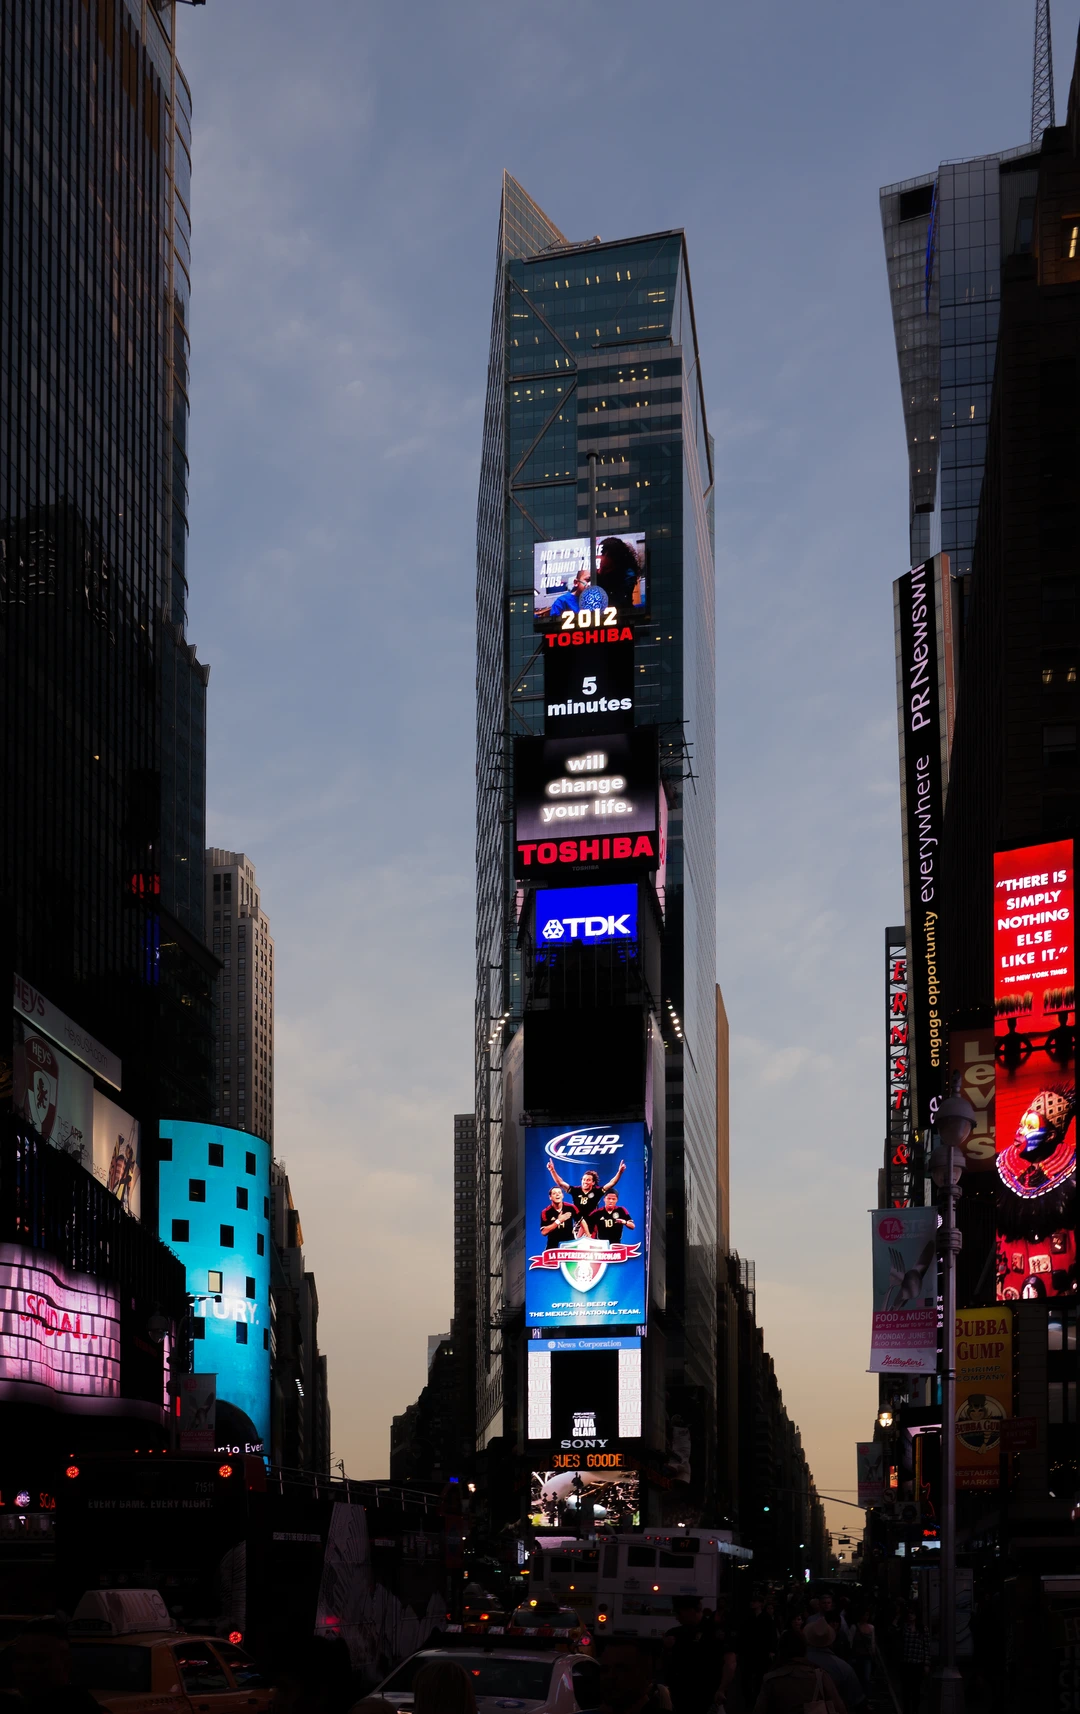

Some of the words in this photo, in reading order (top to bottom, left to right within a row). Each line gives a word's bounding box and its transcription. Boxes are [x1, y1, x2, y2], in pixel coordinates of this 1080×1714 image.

[562, 606, 618, 630] 2012
[544, 627, 634, 648] TOSHIBA
[582, 676, 598, 696] 5
[547, 696, 632, 716] minutes
[568, 754, 605, 770] will
[549, 778, 624, 796] change
[543, 804, 588, 822] your
[594, 799, 633, 816] life.
[914, 754, 938, 902] everywhere
[517, 836, 654, 866] TOSHIBA
[572, 864, 600, 872] TOSHIBA
[1052, 870, 1067, 884] IS
[1006, 890, 1062, 910] SIMPLY
[562, 914, 631, 938] TDK
[997, 908, 1070, 930] NOTHING
[1016, 930, 1052, 946] ELSE
[922, 910, 942, 1006] opportunity
[1002, 952, 1035, 968] LIKE
[1016, 974, 1031, 982] NEW
[1032, 970, 1049, 979] YORK
[1050, 968, 1068, 976] TIMES
[889, 960, 909, 1110] ERNST
[929, 1008, 942, 1068] engage
[32, 1041, 52, 1066] HEYS
[566, 1134, 620, 1146] BUD
[555, 1144, 624, 1156] LIGHT
[604, 1218, 614, 1228] 10
[876, 1313, 898, 1322] FOOD
[906, 1310, 934, 1320] MUSIC
[955, 1318, 1008, 1338] BUBBA
[556, 1341, 576, 1349] News
[578, 1340, 622, 1349] Corporation
[874, 1332, 905, 1341] MONDAY,
[908, 1332, 930, 1340] JUNE
[956, 1342, 1004, 1360] GUMP
[962, 1366, 1000, 1374] SHRIMP
[574, 1418, 594, 1428] VIVA
[572, 1428, 596, 1436] GLAM
[560, 1440, 608, 1449] SONY
[552, 1454, 580, 1468] SUES
[962, 1478, 1000, 1486] MARKET
[88, 1499, 116, 1508] EVERY
[150, 1499, 179, 1508] EVERY
